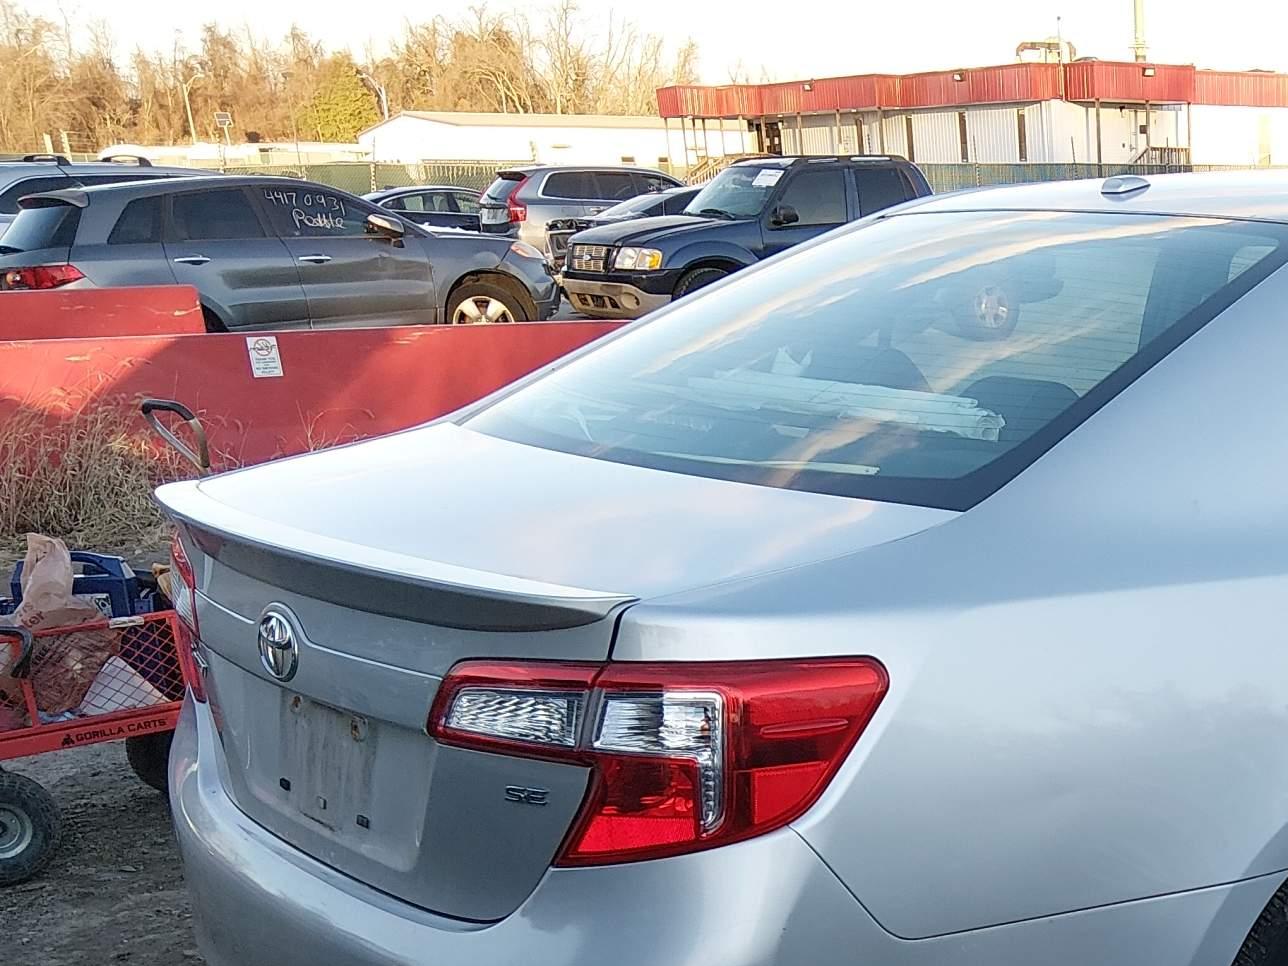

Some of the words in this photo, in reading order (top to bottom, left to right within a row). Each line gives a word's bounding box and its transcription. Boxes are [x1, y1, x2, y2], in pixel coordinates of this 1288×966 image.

[75, 725, 126, 742] GORILLA
[127, 718, 168, 732] CARTS
[504, 784, 549, 805] SE
